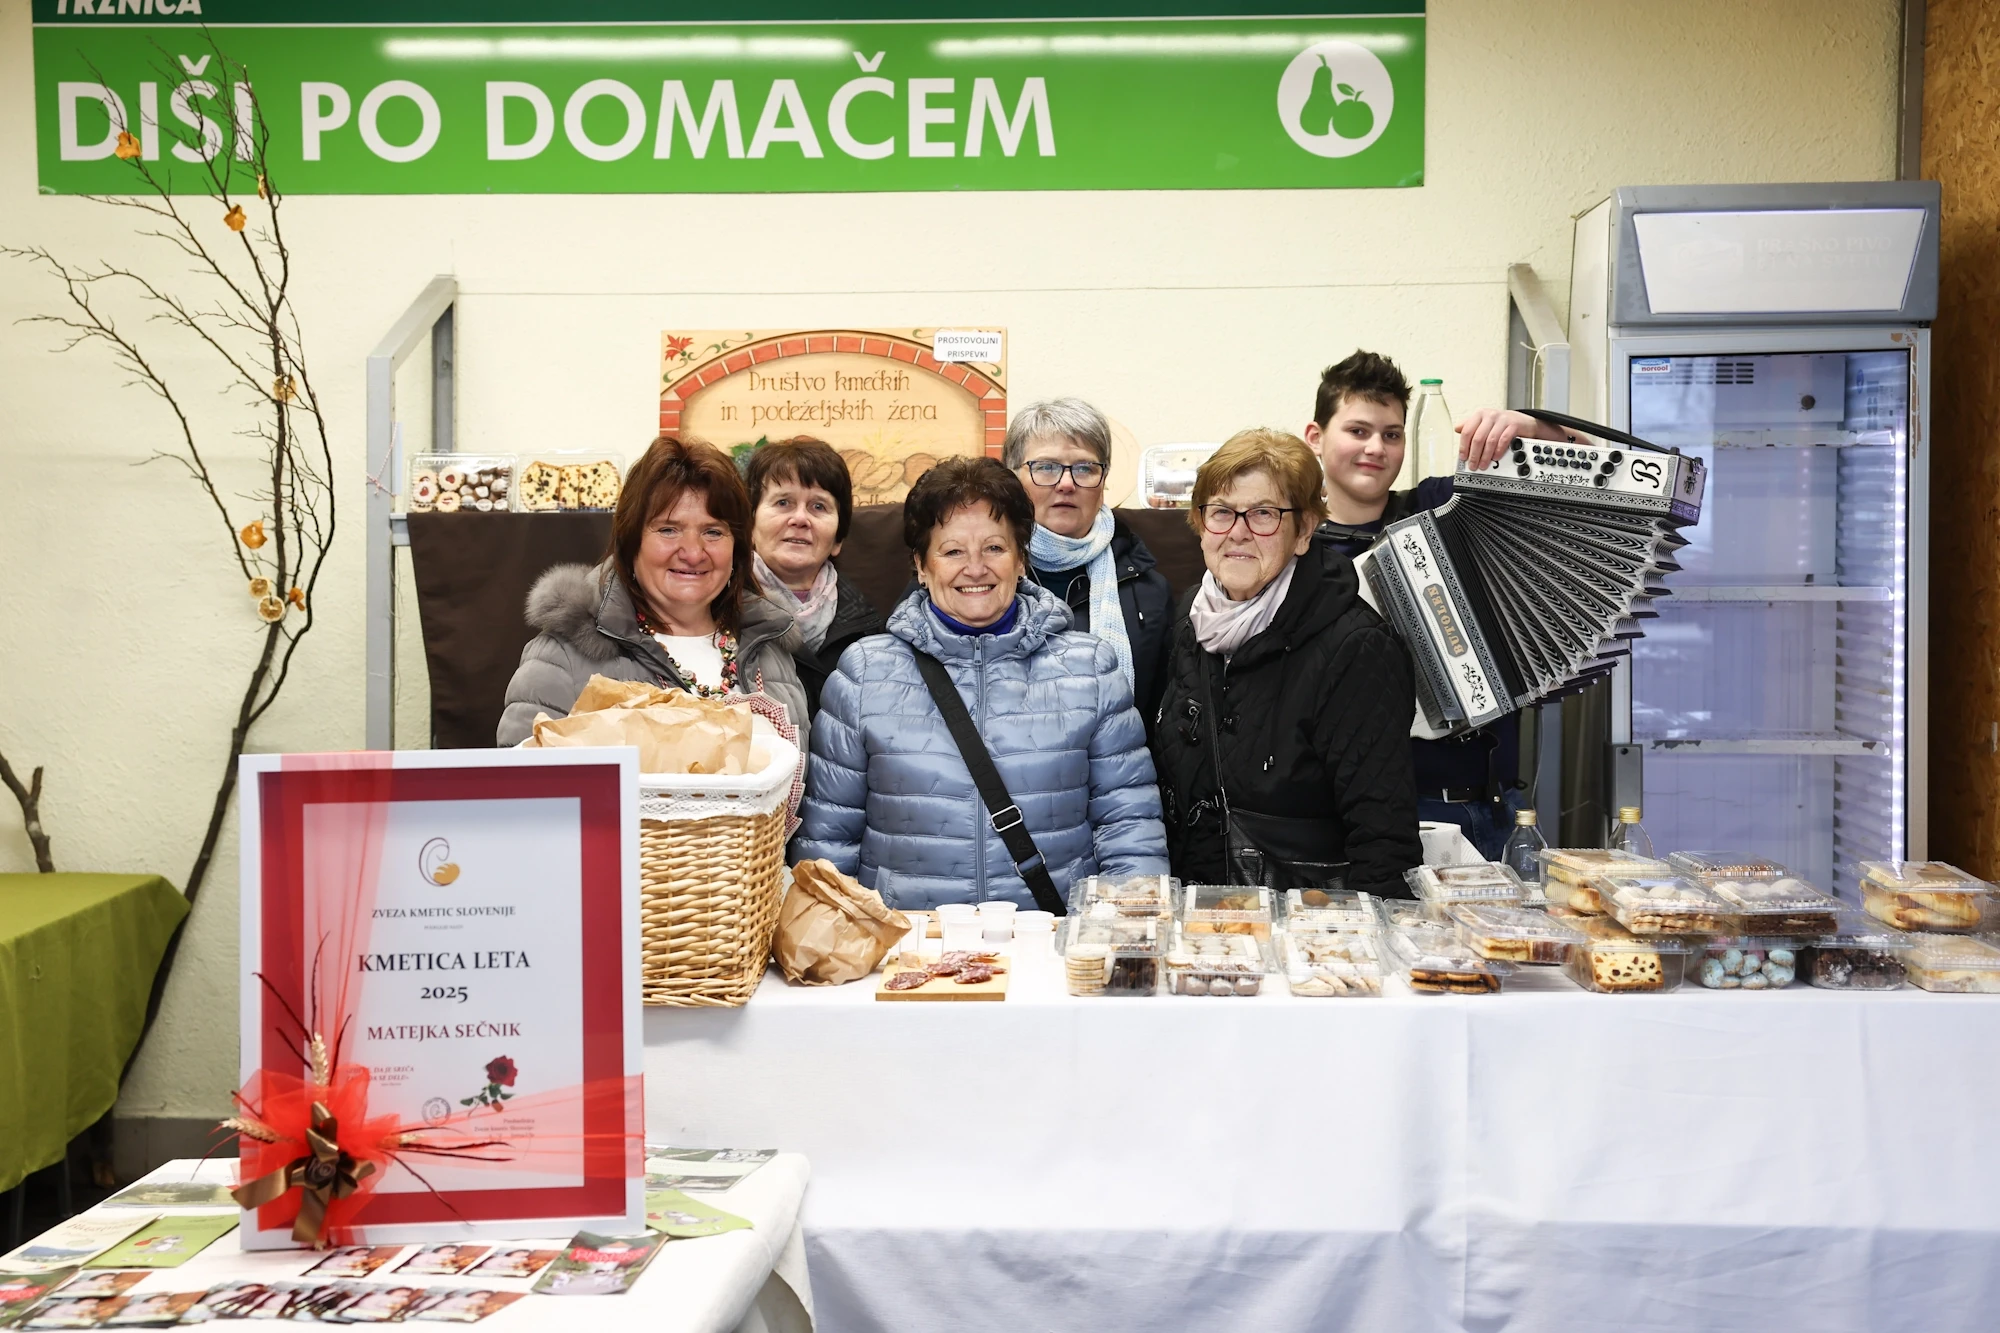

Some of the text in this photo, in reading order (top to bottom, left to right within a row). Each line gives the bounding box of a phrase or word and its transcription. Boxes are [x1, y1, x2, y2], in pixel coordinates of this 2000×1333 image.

[57, 52, 1056, 163] DIŠI PO DOMAČEM
[938, 337, 998, 345] PROSTOVOLJNI
[947, 350, 988, 358] PRISPEVKI
[1642, 365, 1669, 373] norcool
[749, 370, 910, 391] Društvo kmečkih
[720, 401, 739, 421] in
[887, 399, 938, 421] žena
[1631, 458, 1662, 489] B
[1427, 585, 1464, 655] BUTOLEN
[372, 905, 516, 919] ZVEZA KMETIC SLOVENIJE
[357, 950, 531, 973] KMETICA LETA
[420, 986, 469, 1004] 2025
[367, 1020, 521, 1043] MATEJKA SEČNIK
